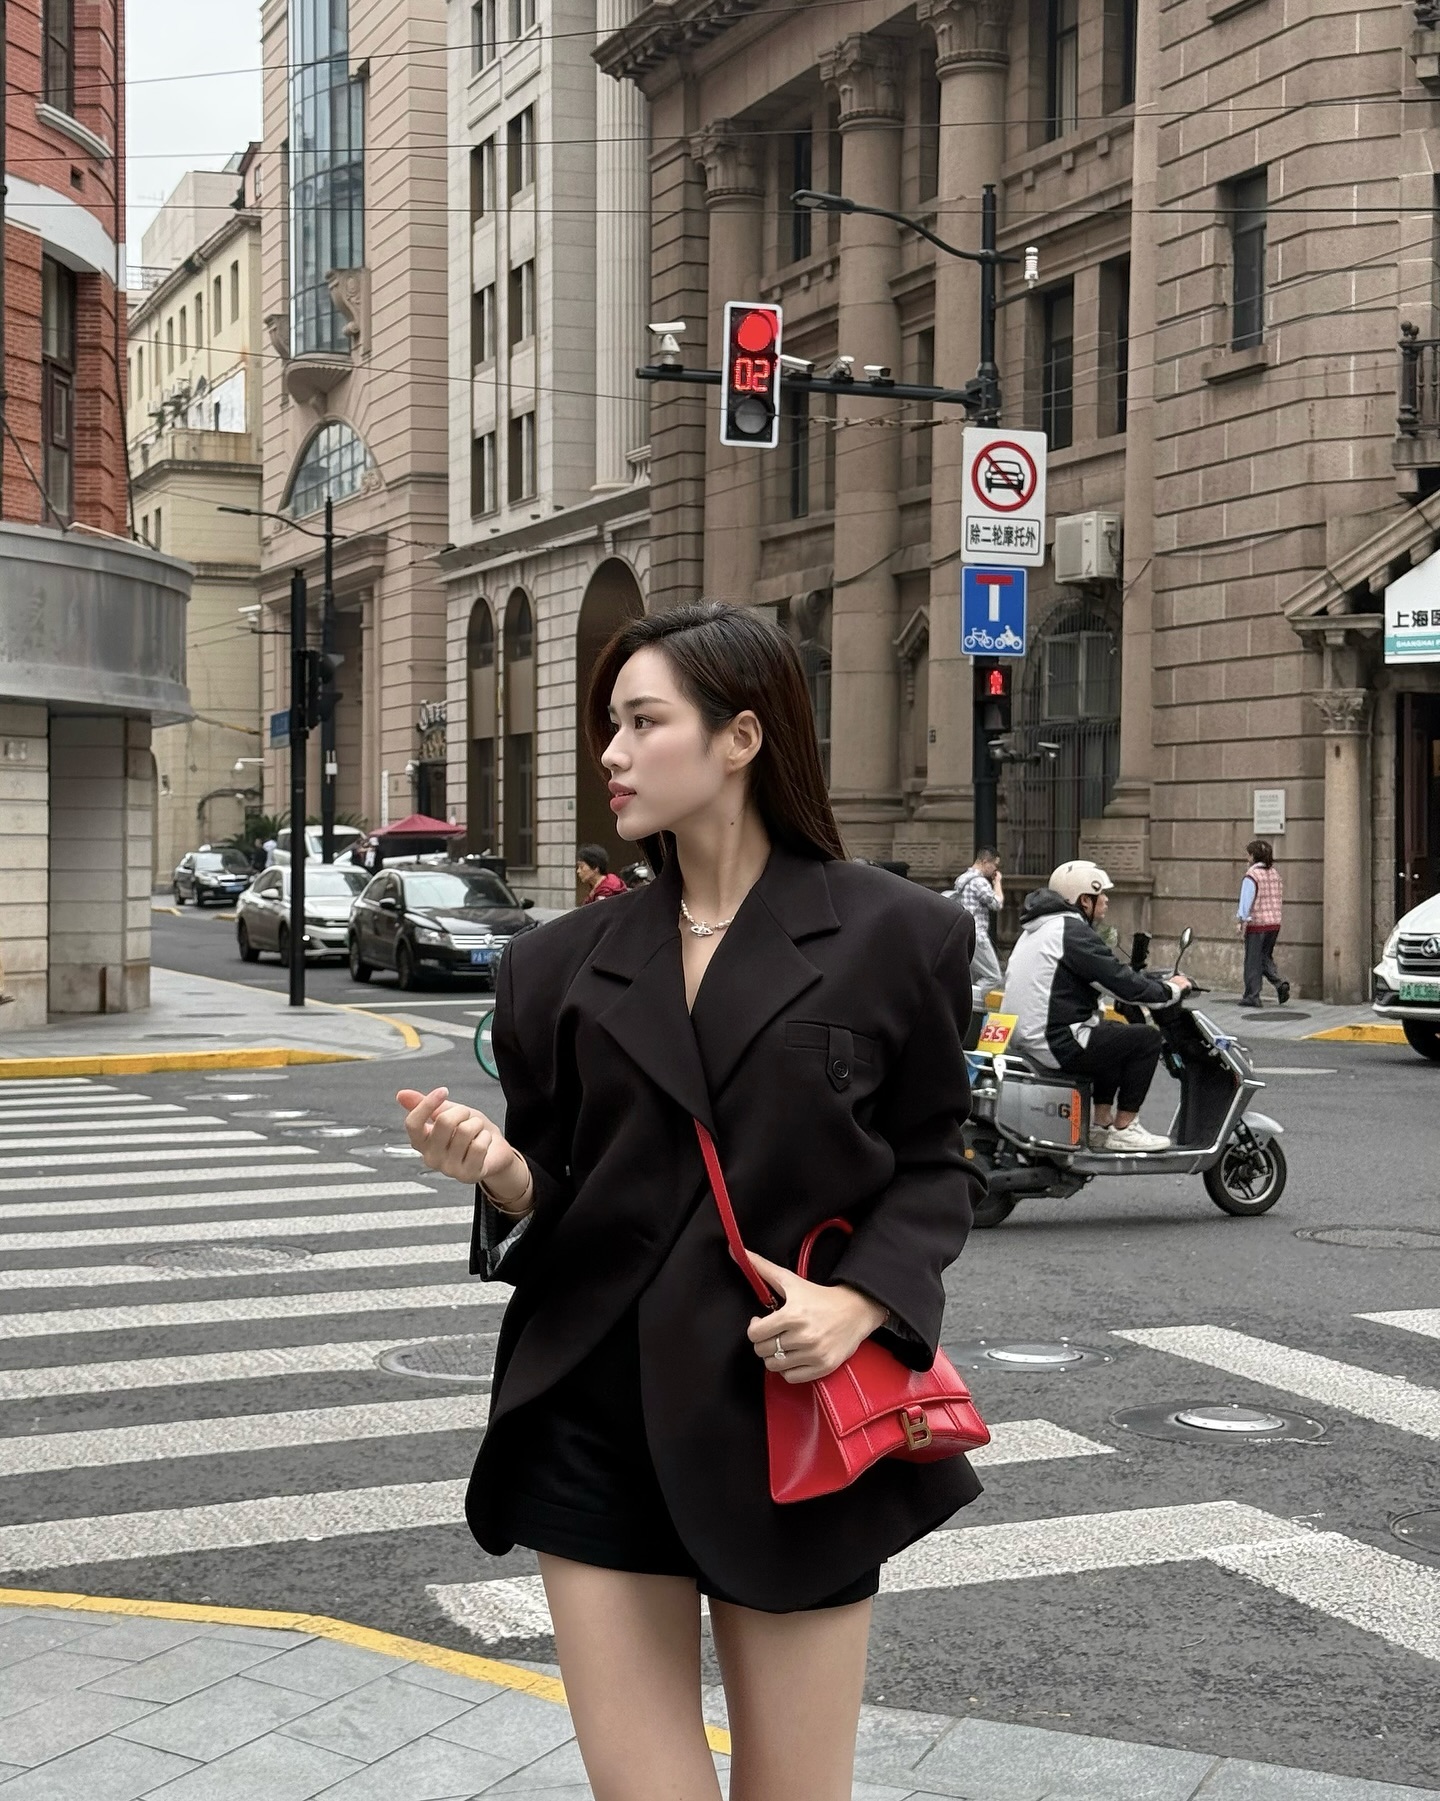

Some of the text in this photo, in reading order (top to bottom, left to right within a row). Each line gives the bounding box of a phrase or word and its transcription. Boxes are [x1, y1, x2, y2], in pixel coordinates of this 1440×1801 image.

[734, 357, 770, 392] 02
[970, 523, 1036, 548] 除二轮摩托外
[902, 1409, 933, 1450] B
